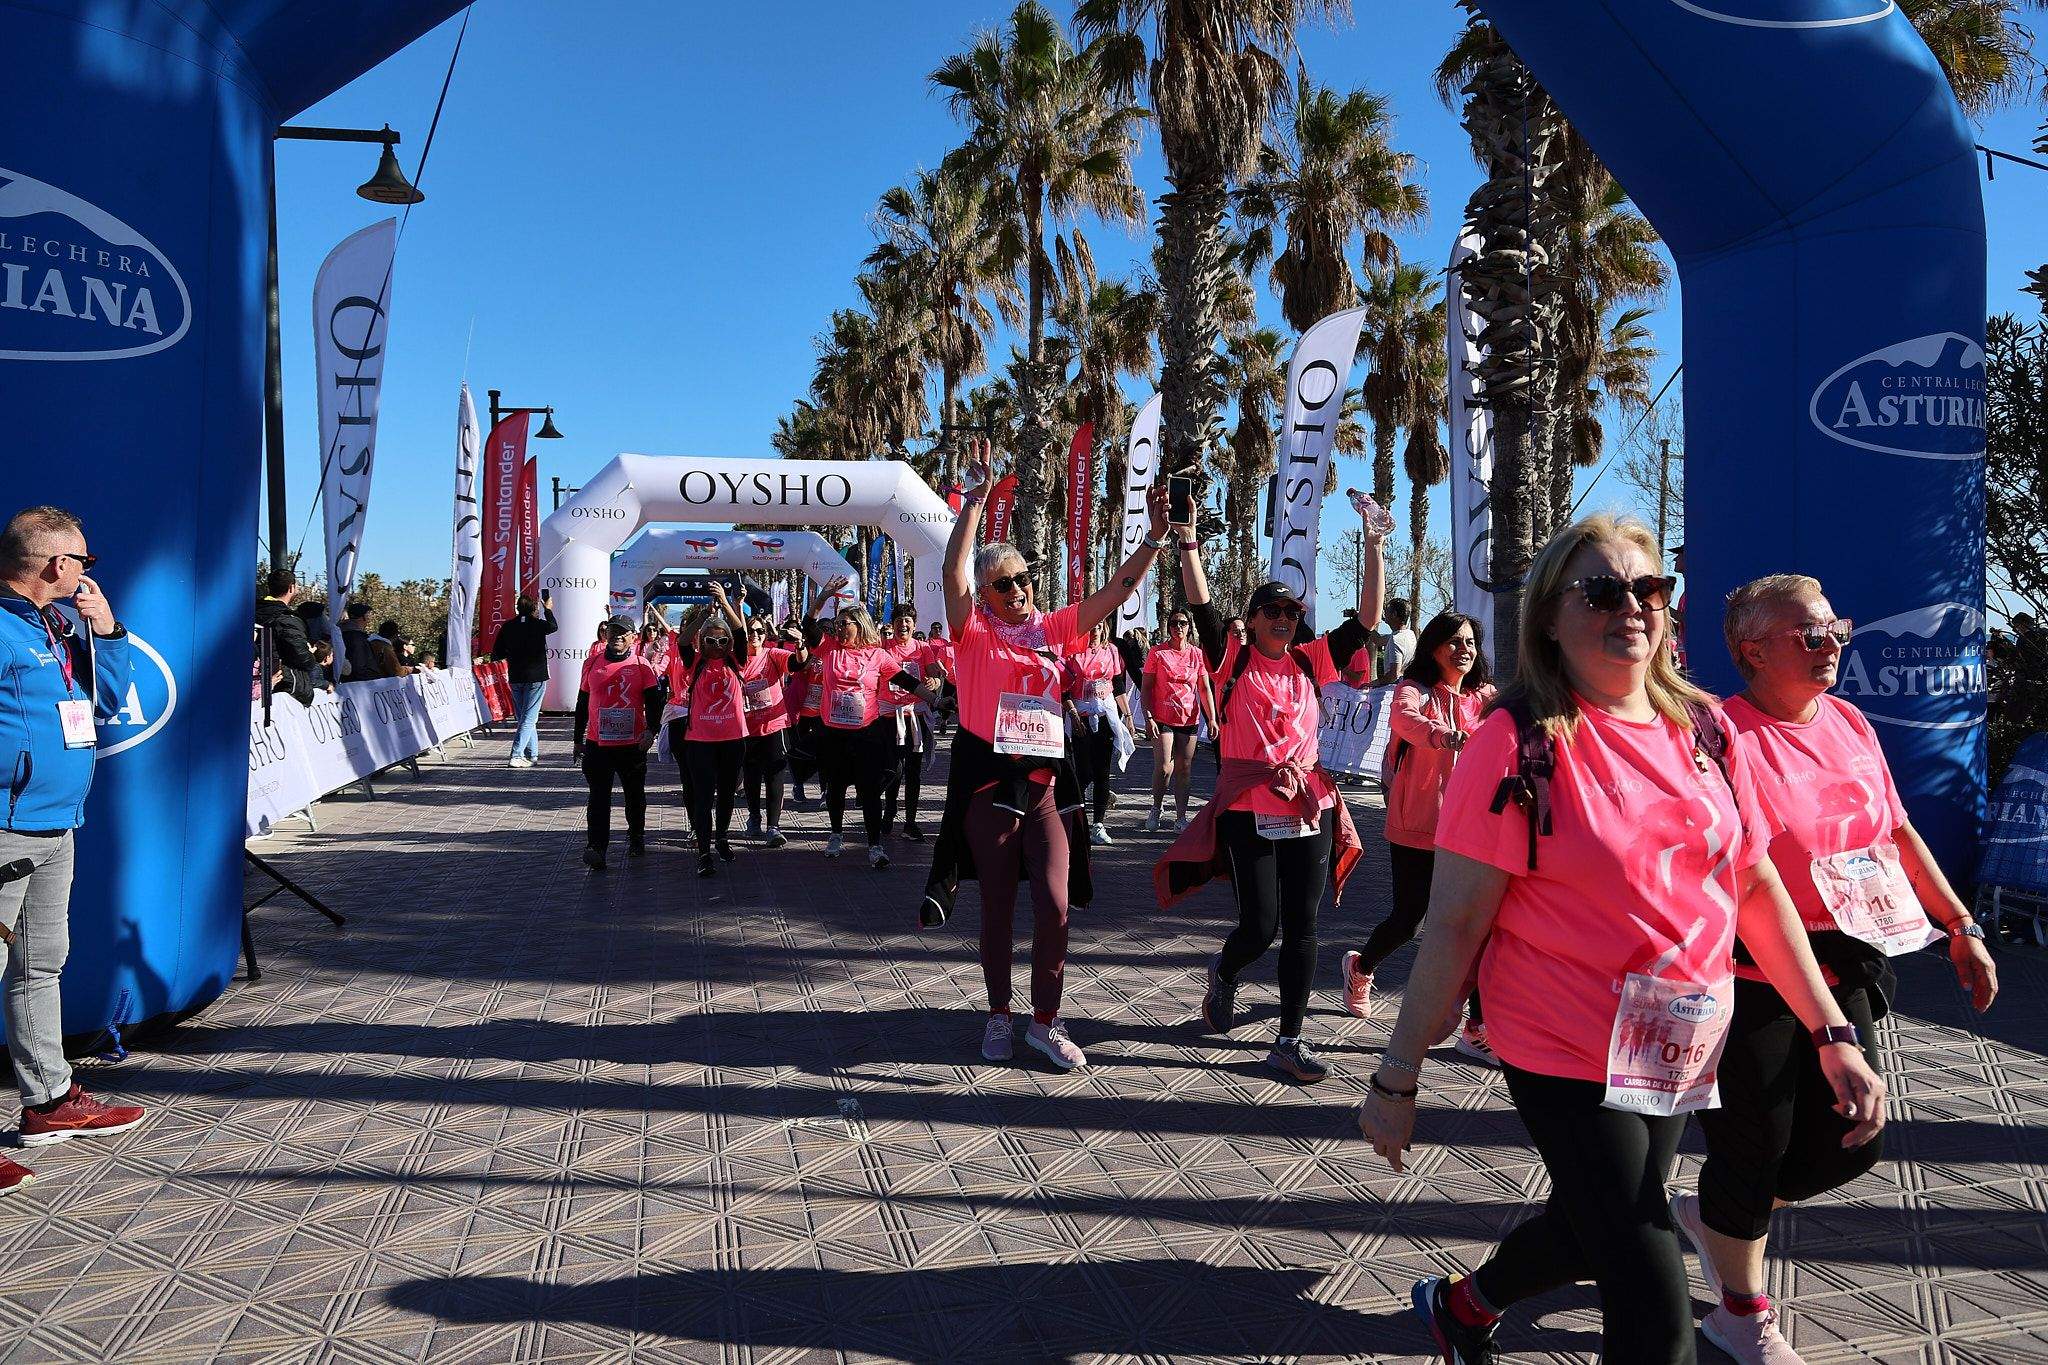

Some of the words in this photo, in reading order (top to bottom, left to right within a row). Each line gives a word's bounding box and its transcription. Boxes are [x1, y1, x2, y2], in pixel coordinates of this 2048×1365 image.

[1882, 376, 1959, 388] CENTRAL
[494, 440, 516, 543] Santander
[679, 470, 852, 508] OYSHO
[1073, 452, 1086, 551] Santander
[571, 507, 626, 520] OYSHO
[899, 512, 948, 524] OYSHO
[522, 483, 532, 565] Santander
[546, 577, 597, 590] OYSHO
[1882, 646, 1959, 658] CENTRAL
[1020, 722, 1045, 733] 016
[1874, 916, 1895, 928] 1780
[1661, 1042, 1706, 1066] 016
[1624, 1077, 1651, 1088] CARRERA
[1620, 1093, 1660, 1107] OYSHO
